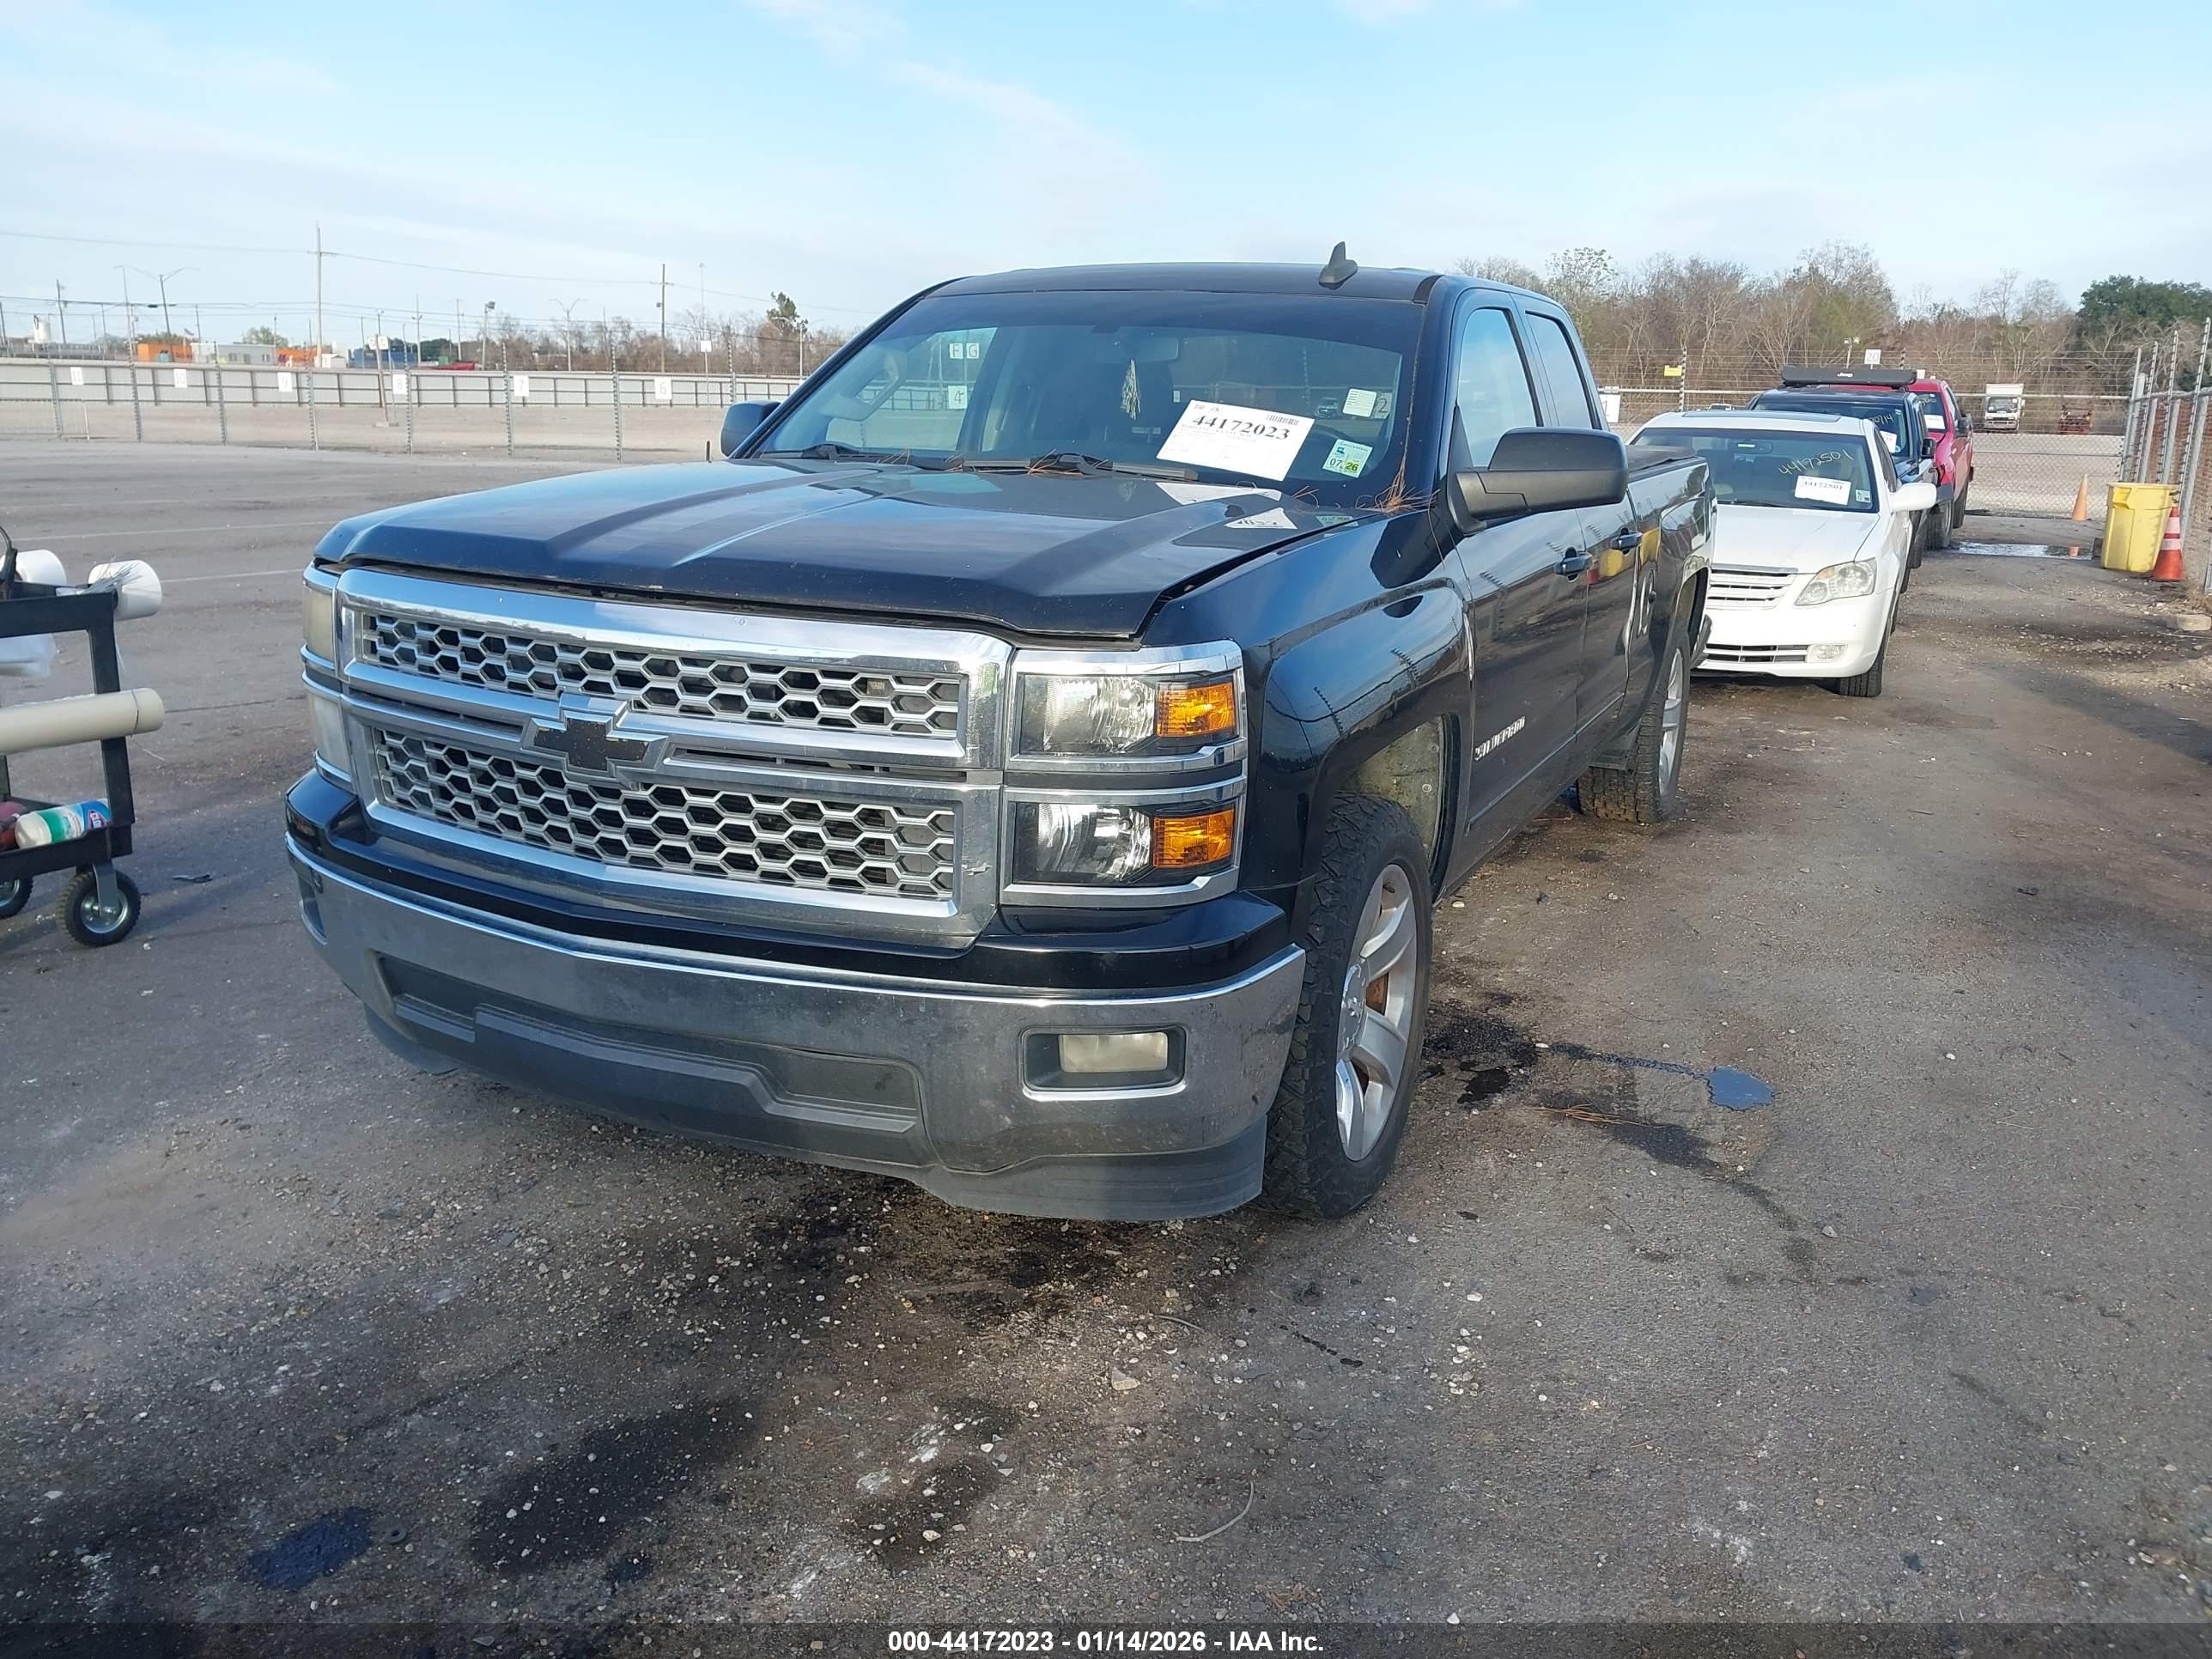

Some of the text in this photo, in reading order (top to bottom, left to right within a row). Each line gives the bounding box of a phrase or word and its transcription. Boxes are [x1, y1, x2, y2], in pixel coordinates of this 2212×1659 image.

[952, 343, 978, 358] F G
[1867, 352, 1880, 362] 20
[659, 380, 667, 395] 6
[954, 391, 964, 404] 4
[1192, 415, 1291, 441] 44172023
[1329, 458, 1358, 471] 07 26
[1778, 449, 1855, 475] 44172501
